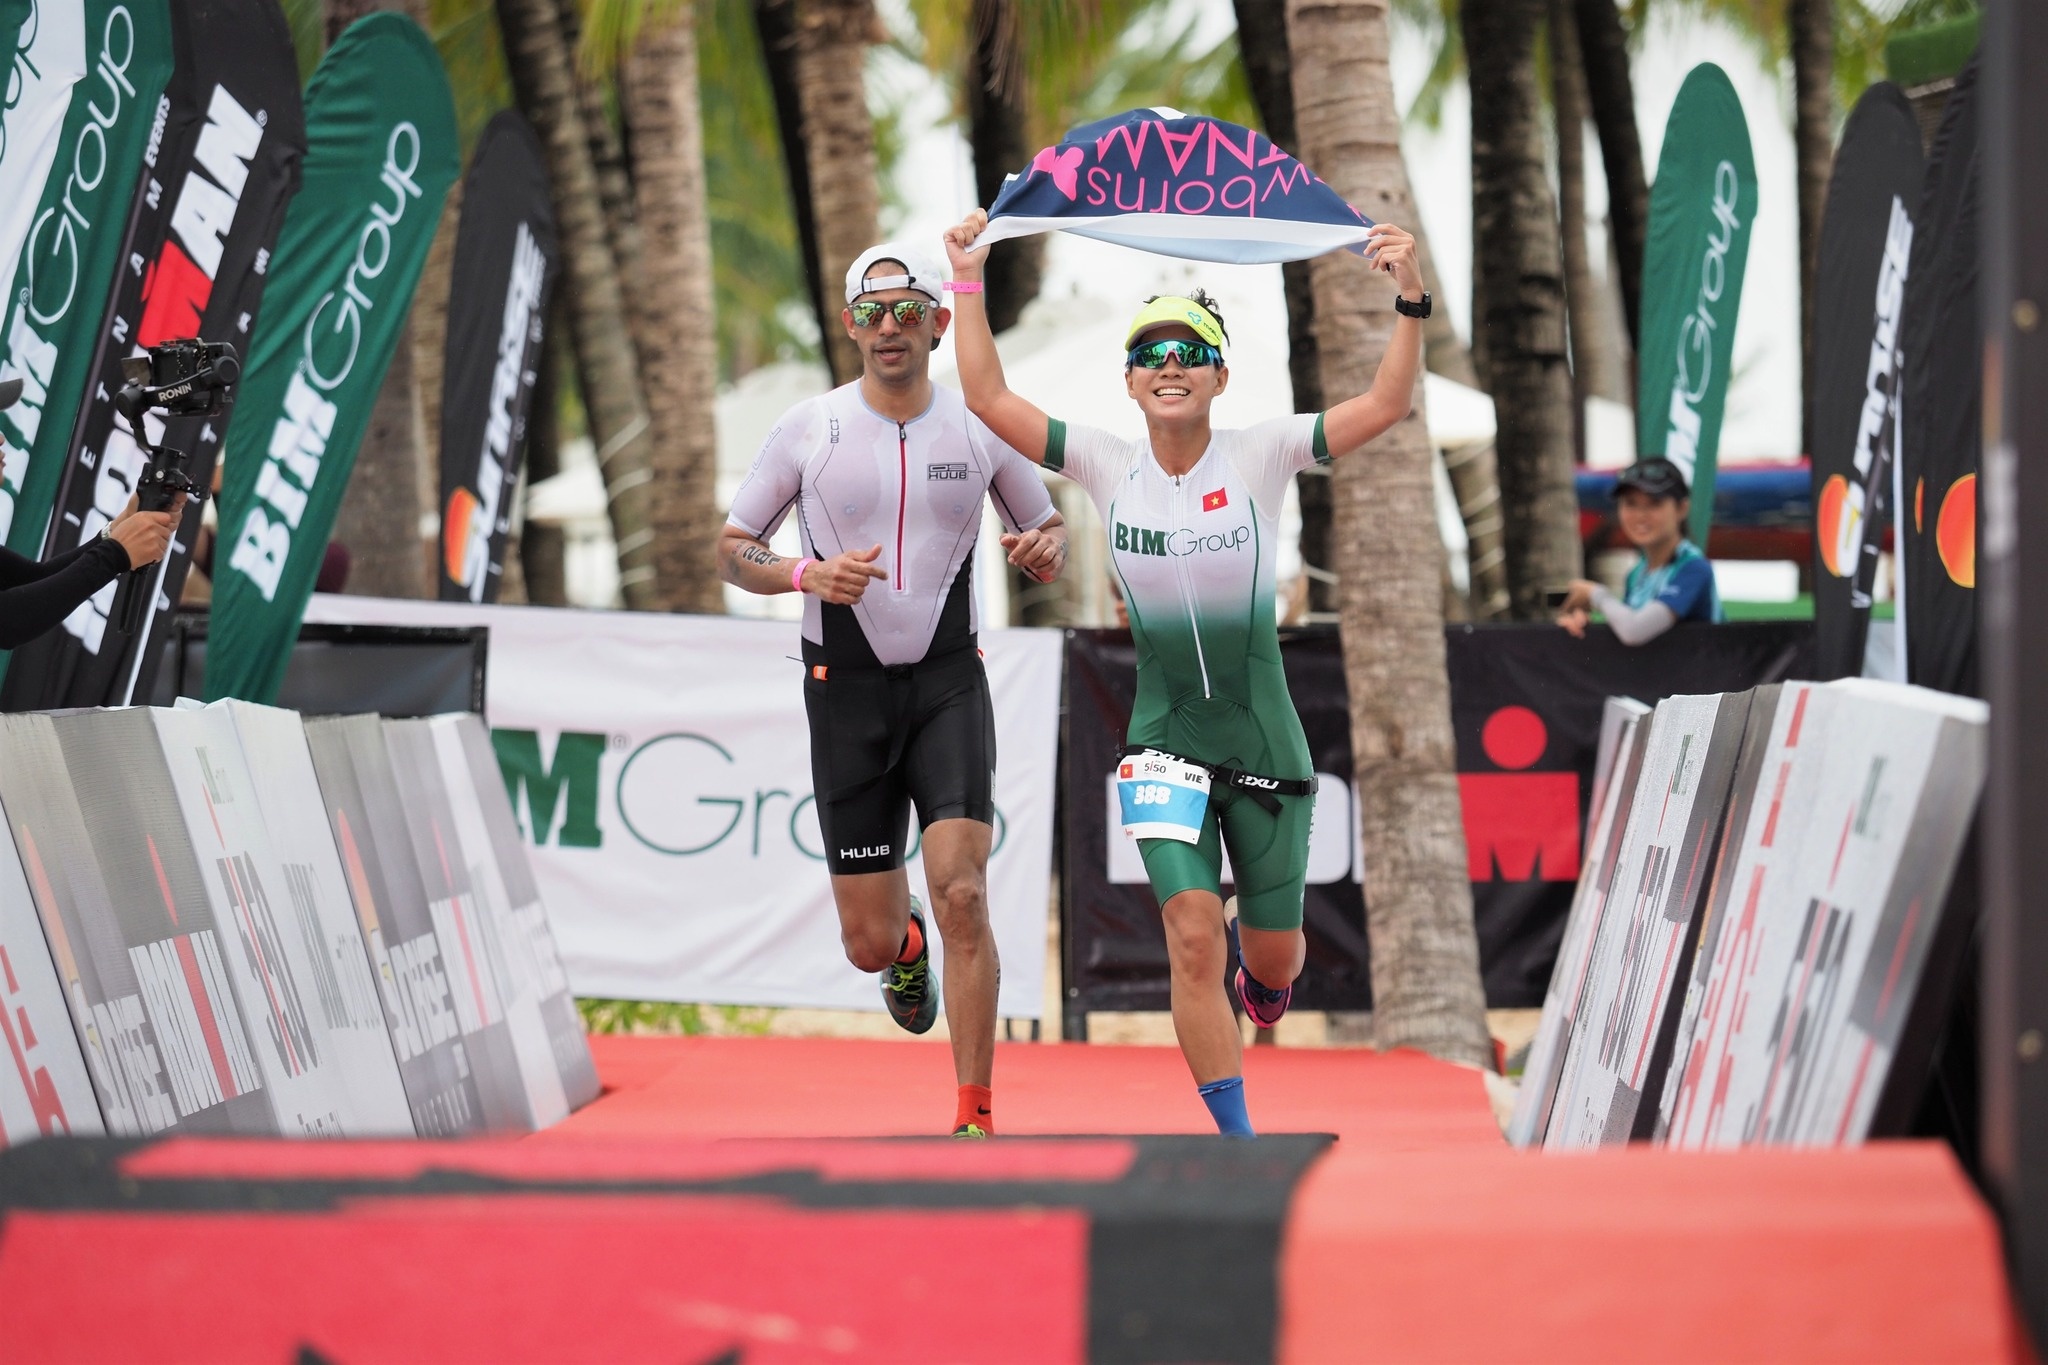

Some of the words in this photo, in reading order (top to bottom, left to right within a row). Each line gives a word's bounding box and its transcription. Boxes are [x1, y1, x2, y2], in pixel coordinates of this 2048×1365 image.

[145, 92, 171, 168] EVENTS
[28, 5, 136, 325] Group
[1096, 120, 1289, 176] TNAM
[1087, 162, 1366, 223] wborns
[1677, 160, 1740, 403] Group
[229, 372, 337, 601] BIM
[305, 121, 422, 389] Group
[158, 383, 192, 401] RONIN
[829, 418, 840, 444] HUUB
[929, 471, 967, 480] HUUB
[1115, 521, 1167, 556] BIM
[1167, 526, 1249, 556] Group
[1134, 784, 1171, 805] 388
[1184, 771, 1203, 784] VIE
[840, 845, 890, 860] HUUB
